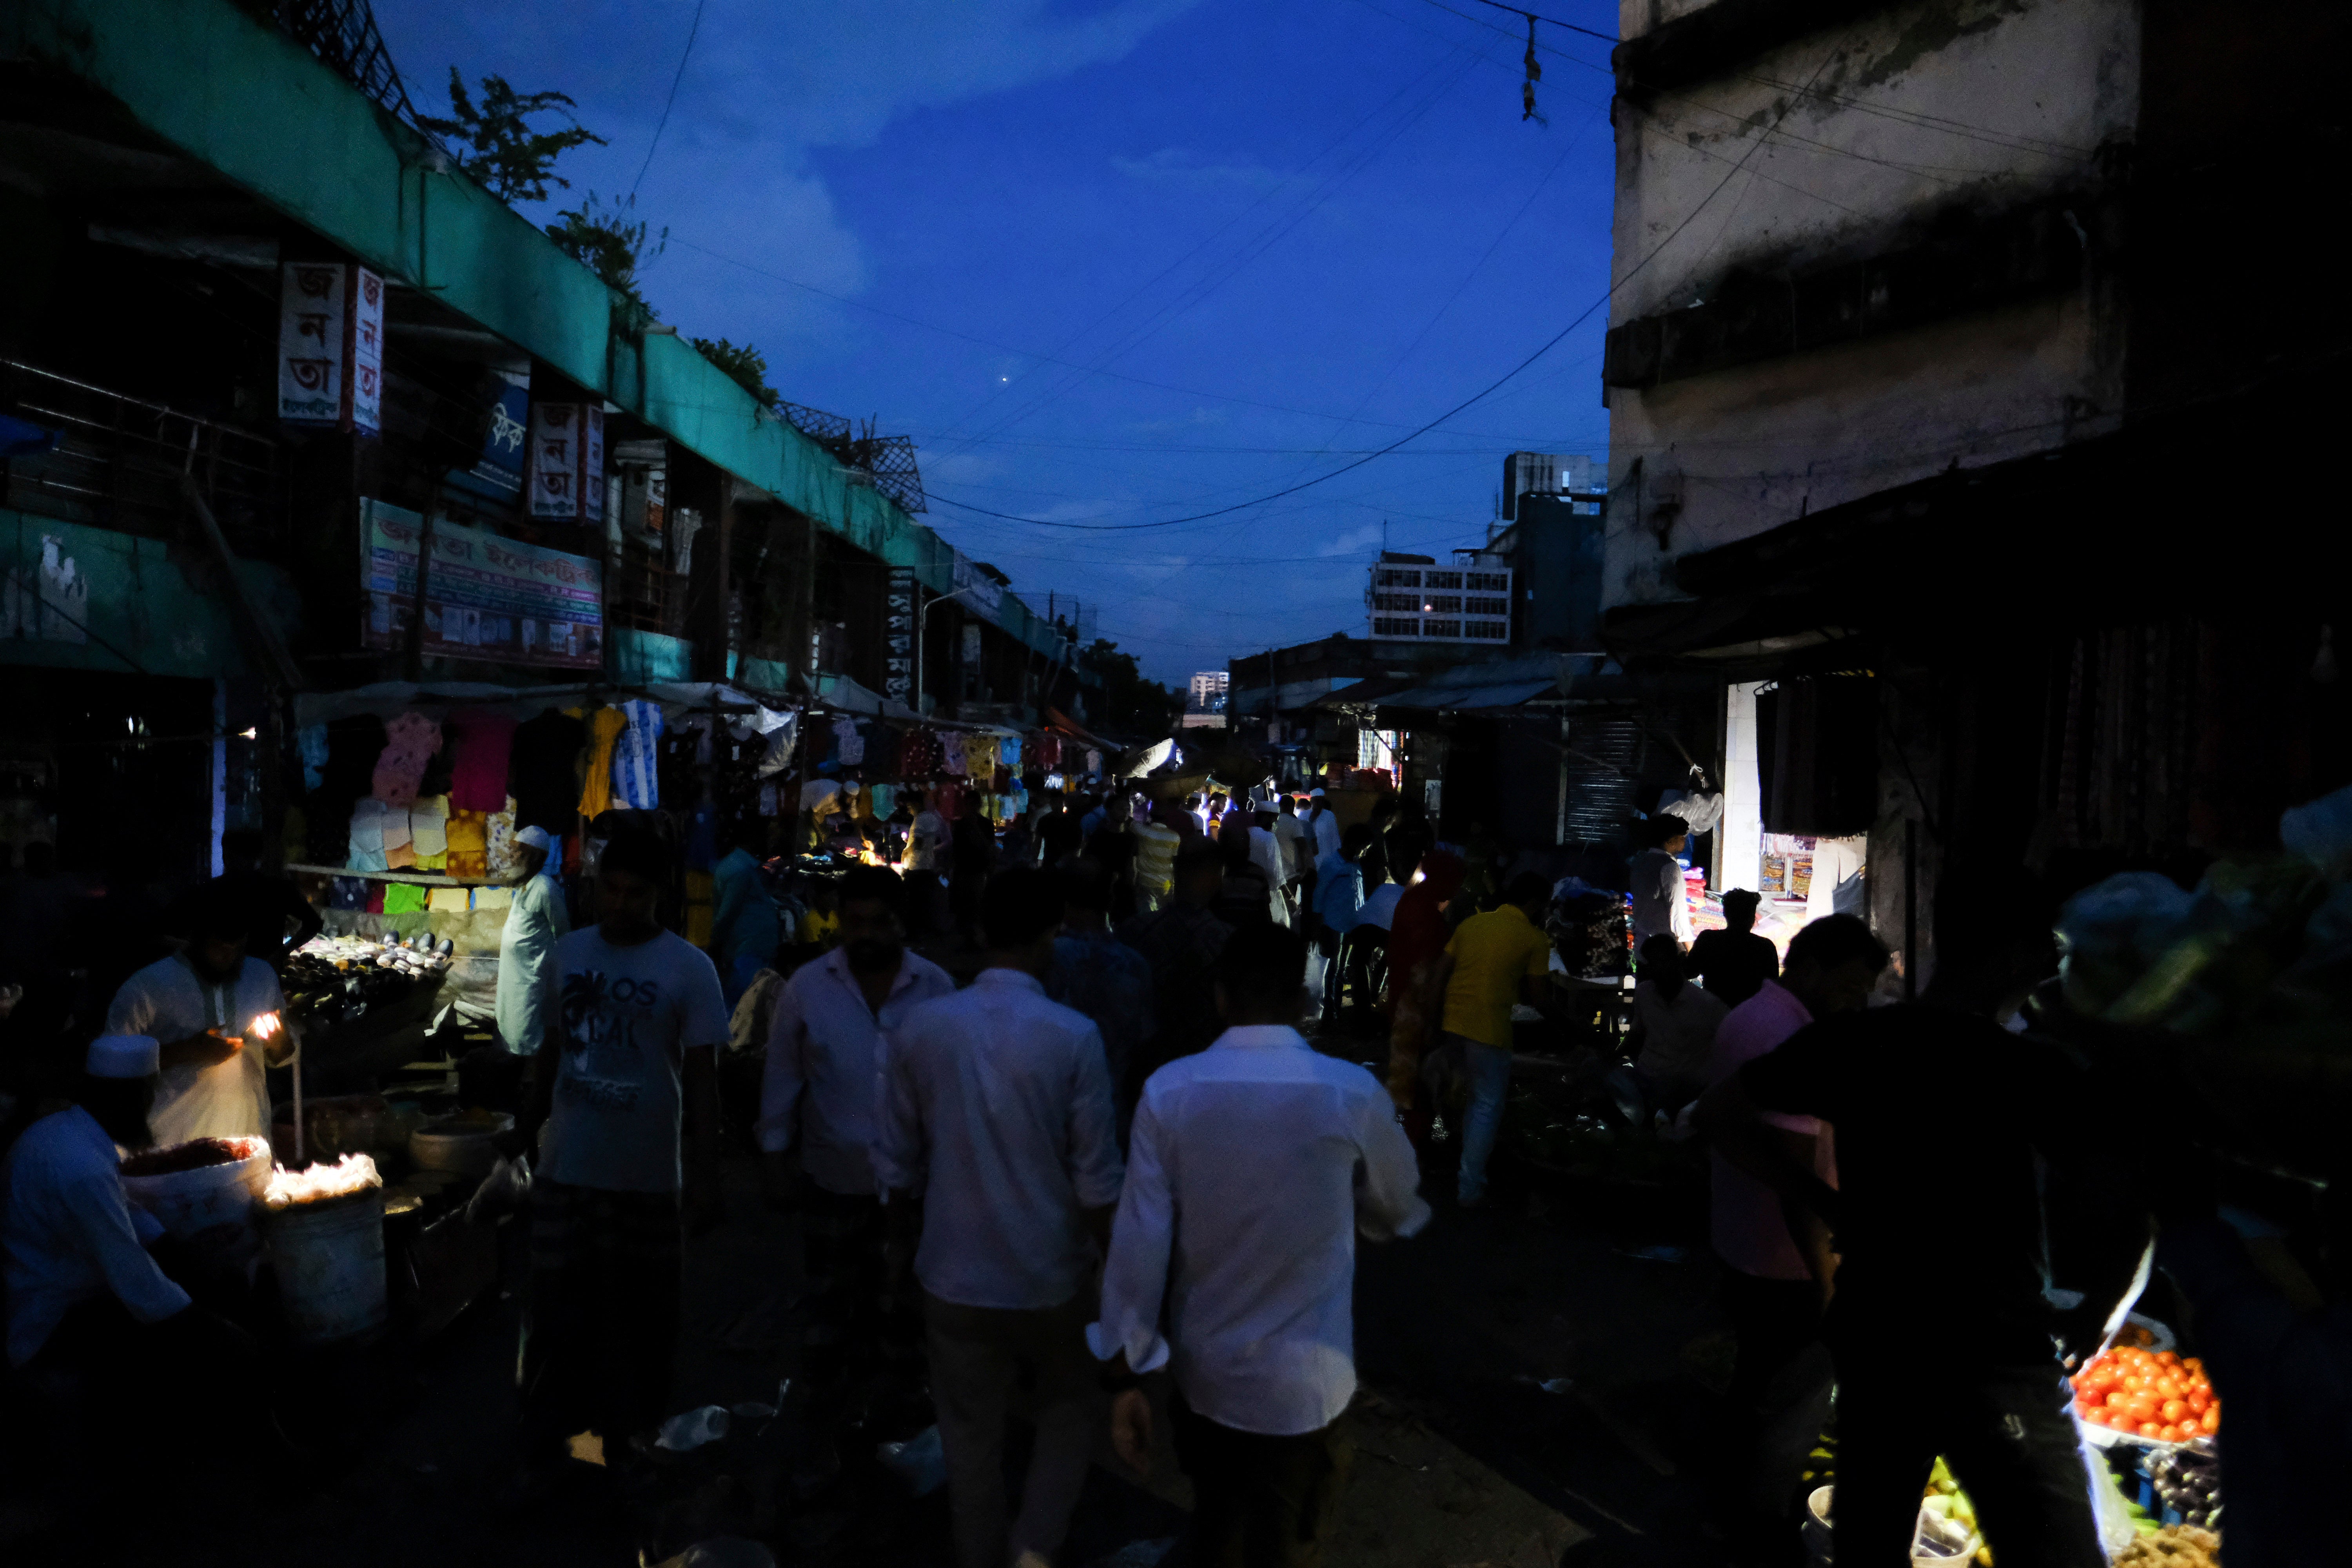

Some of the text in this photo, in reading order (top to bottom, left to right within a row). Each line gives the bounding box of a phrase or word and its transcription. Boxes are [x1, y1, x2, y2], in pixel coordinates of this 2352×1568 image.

[289, 267, 336, 394] জনতা
[358, 274, 380, 399] জনতা
[540, 406, 571, 496] জনতা
